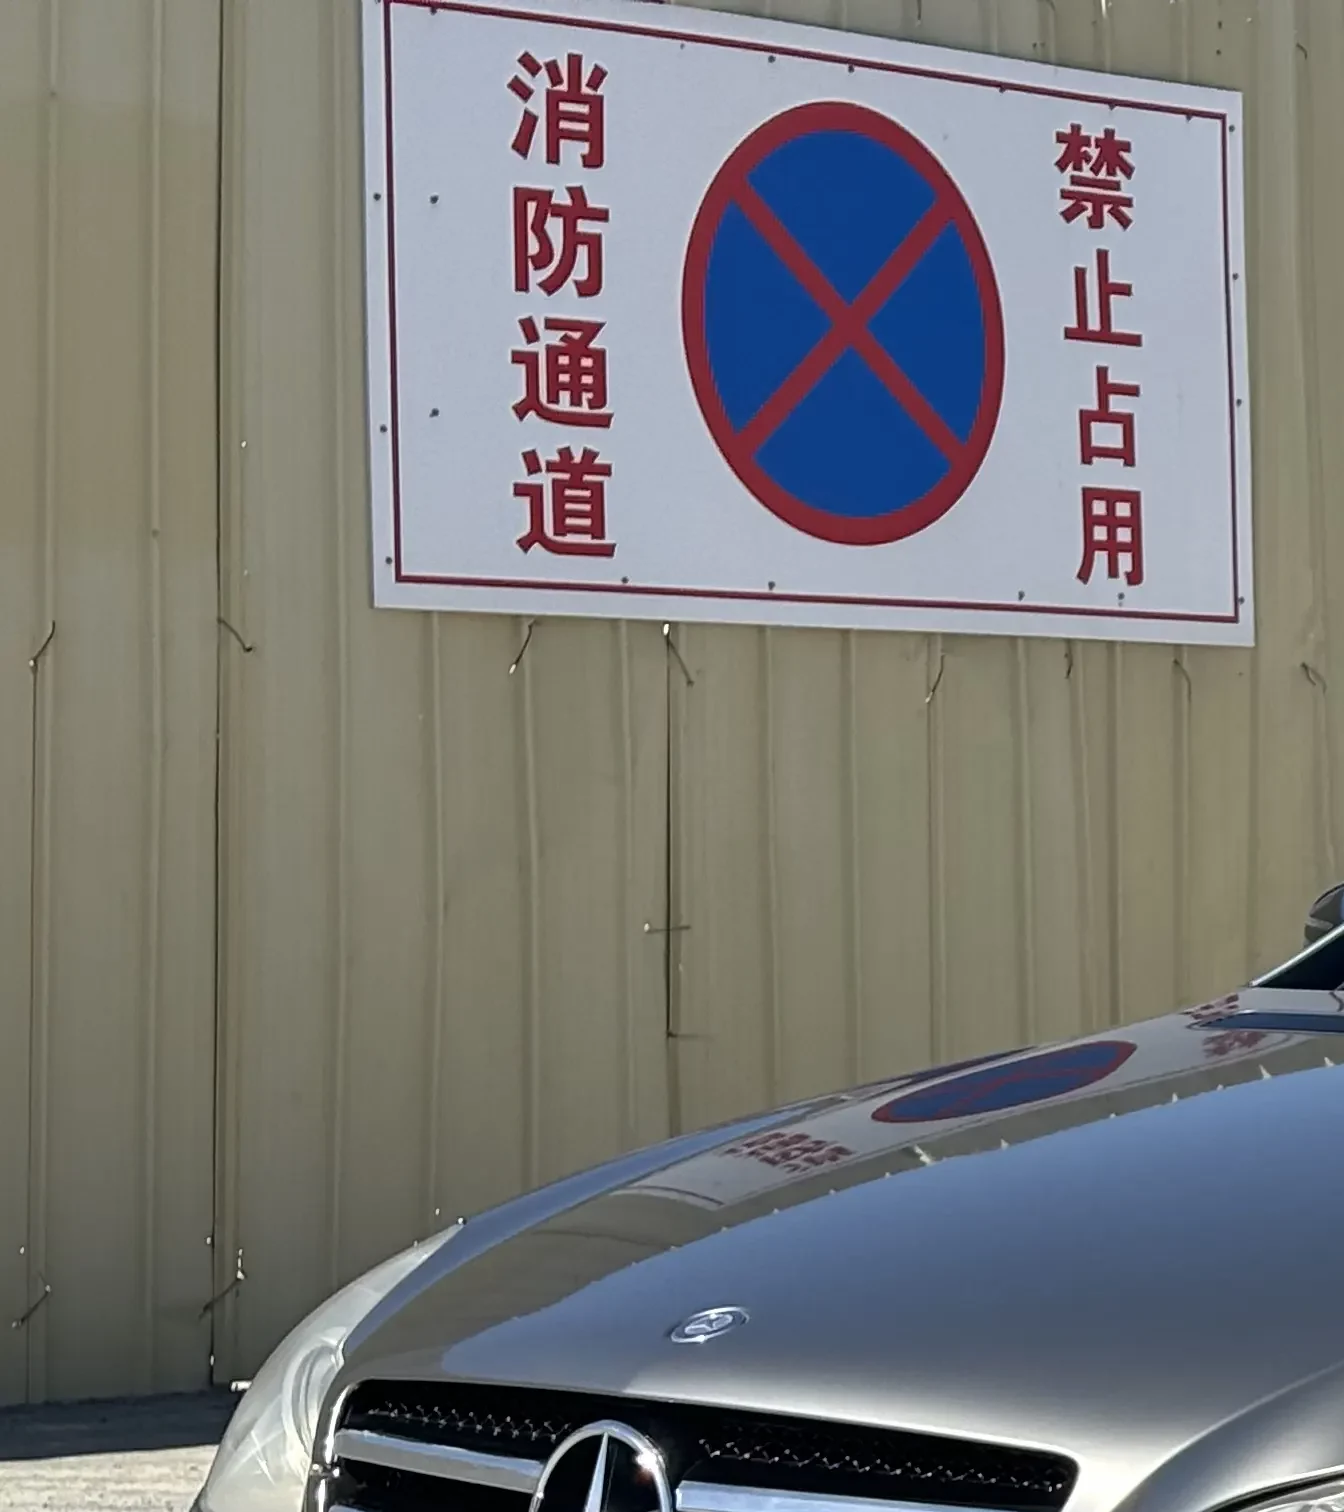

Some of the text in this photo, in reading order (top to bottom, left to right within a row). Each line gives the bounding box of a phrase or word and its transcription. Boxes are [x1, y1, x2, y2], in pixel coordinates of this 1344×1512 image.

[508, 52, 615, 558] 消防通道
[1055, 124, 1143, 586] 禁止占用
